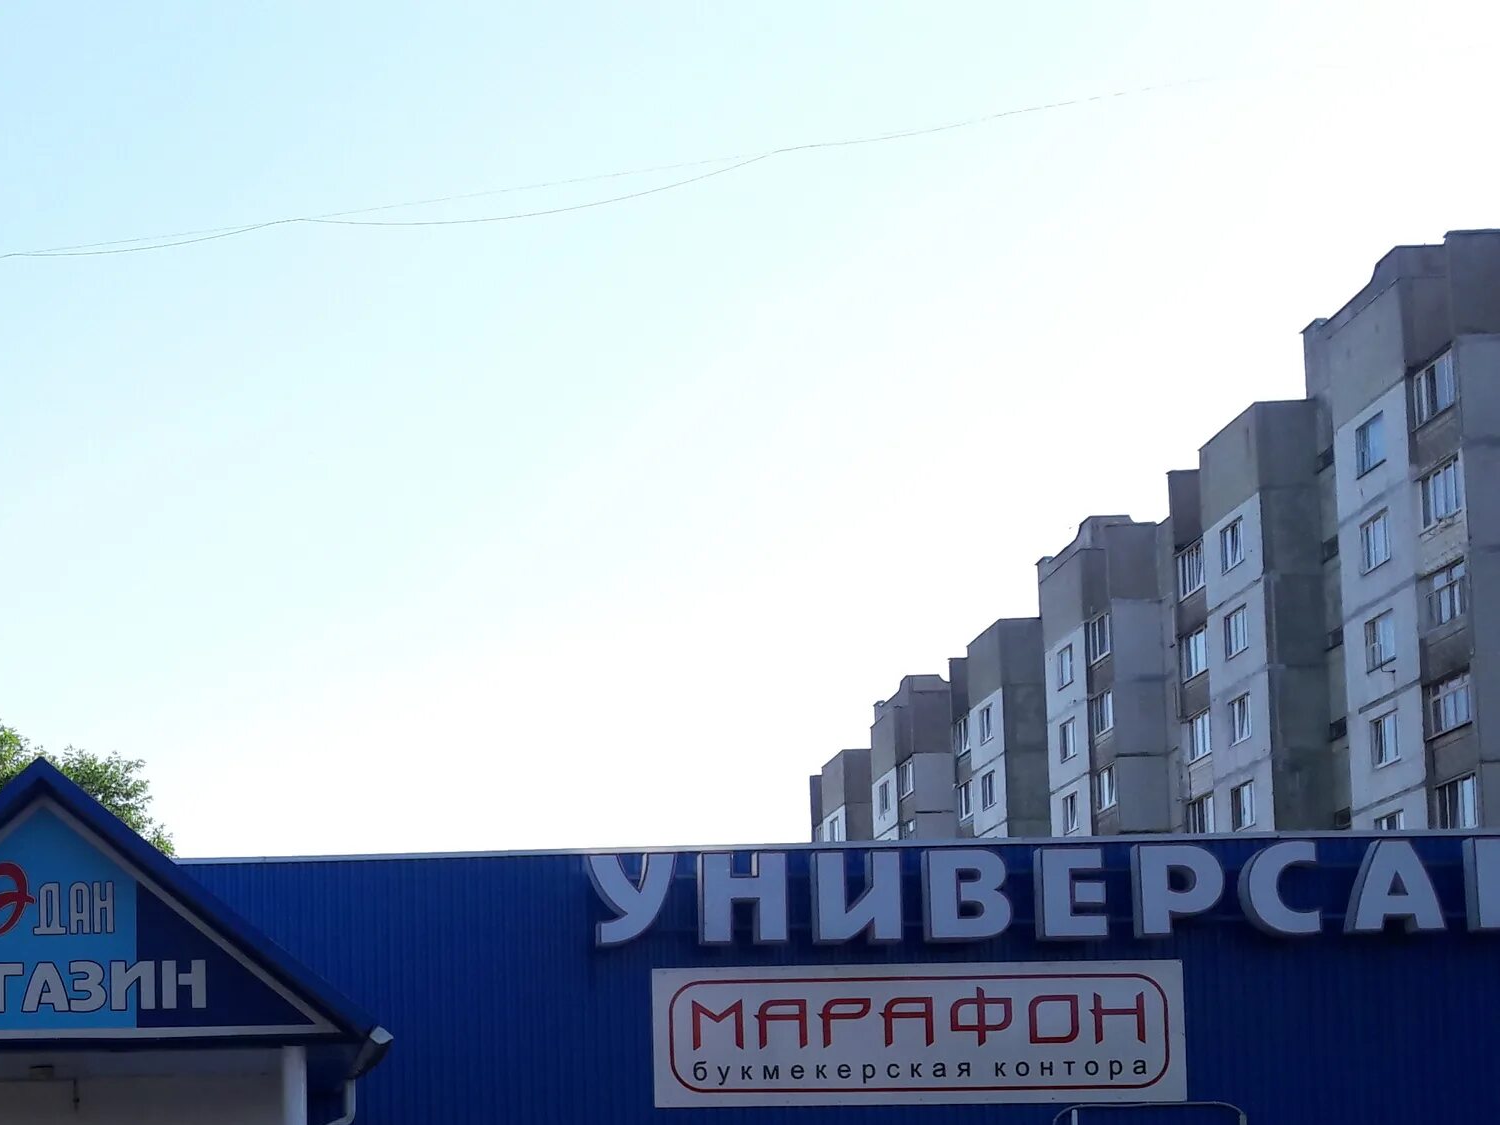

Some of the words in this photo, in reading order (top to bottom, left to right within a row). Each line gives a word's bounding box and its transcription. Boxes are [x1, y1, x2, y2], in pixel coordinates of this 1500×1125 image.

[586, 838, 1500, 947] УНИВЕРСА
[690, 986, 1148, 1052] МАРАФОН
[692, 1058, 973, 1085] букмекерская
[993, 1056, 1149, 1083] контора
